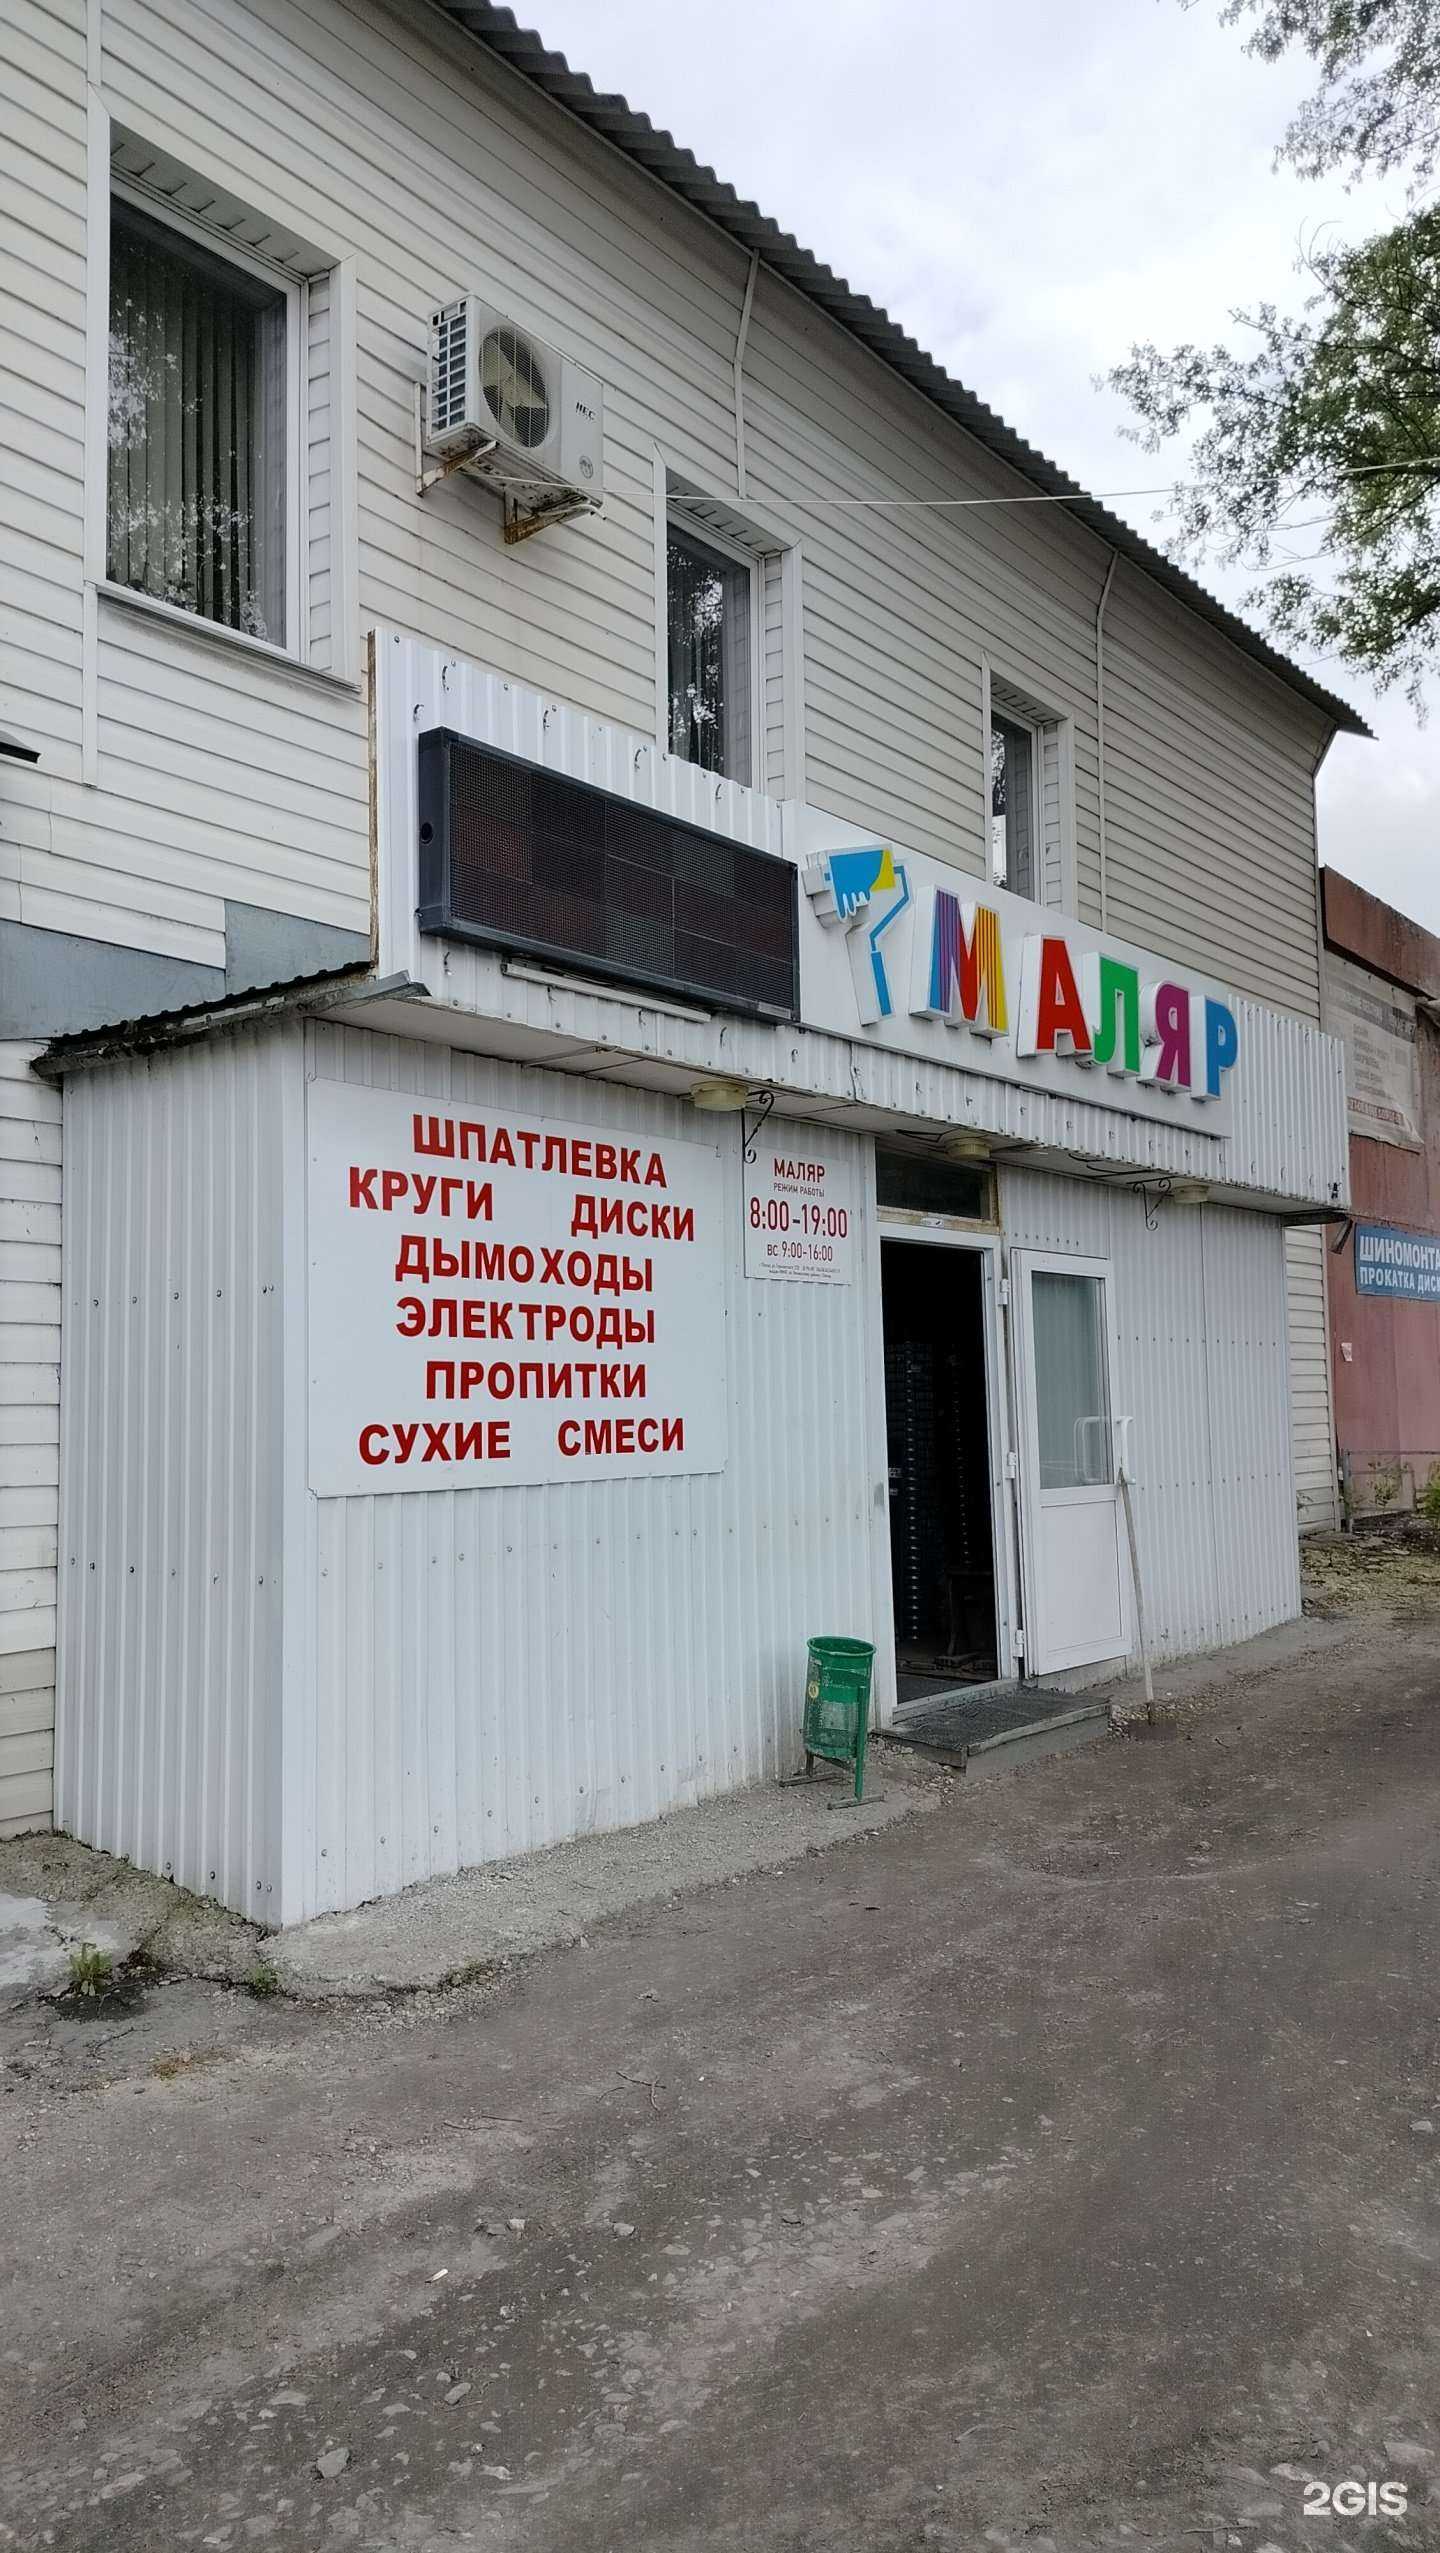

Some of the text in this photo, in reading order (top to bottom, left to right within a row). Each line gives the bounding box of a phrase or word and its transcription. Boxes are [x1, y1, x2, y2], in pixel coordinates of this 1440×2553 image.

[911, 885, 1238, 1101] МАЛЯР
[413, 1114, 667, 1188] ШПАТЛЕВКА
[773, 1158, 825, 1183] МАЛЯР
[349, 1166, 694, 1242] КРУГИ ДИСКИ
[773, 1182, 825, 1197] РЕЖИМ РАБОТЫ
[750, 1197, 848, 1238] 8:00-19:00
[395, 1234, 653, 1297] ДЫМОХОДЫ
[767, 1241, 833, 1262] ВС 9:00-16:00
[1359, 1266, 1415, 1290] ПРОКАТКА
[395, 1296, 655, 1350] ЭЛЕКТРОДЫ
[426, 1360, 646, 1400] ПРОПИТКИ
[358, 1417, 684, 1465] СУХИЕ СМЕСИ
